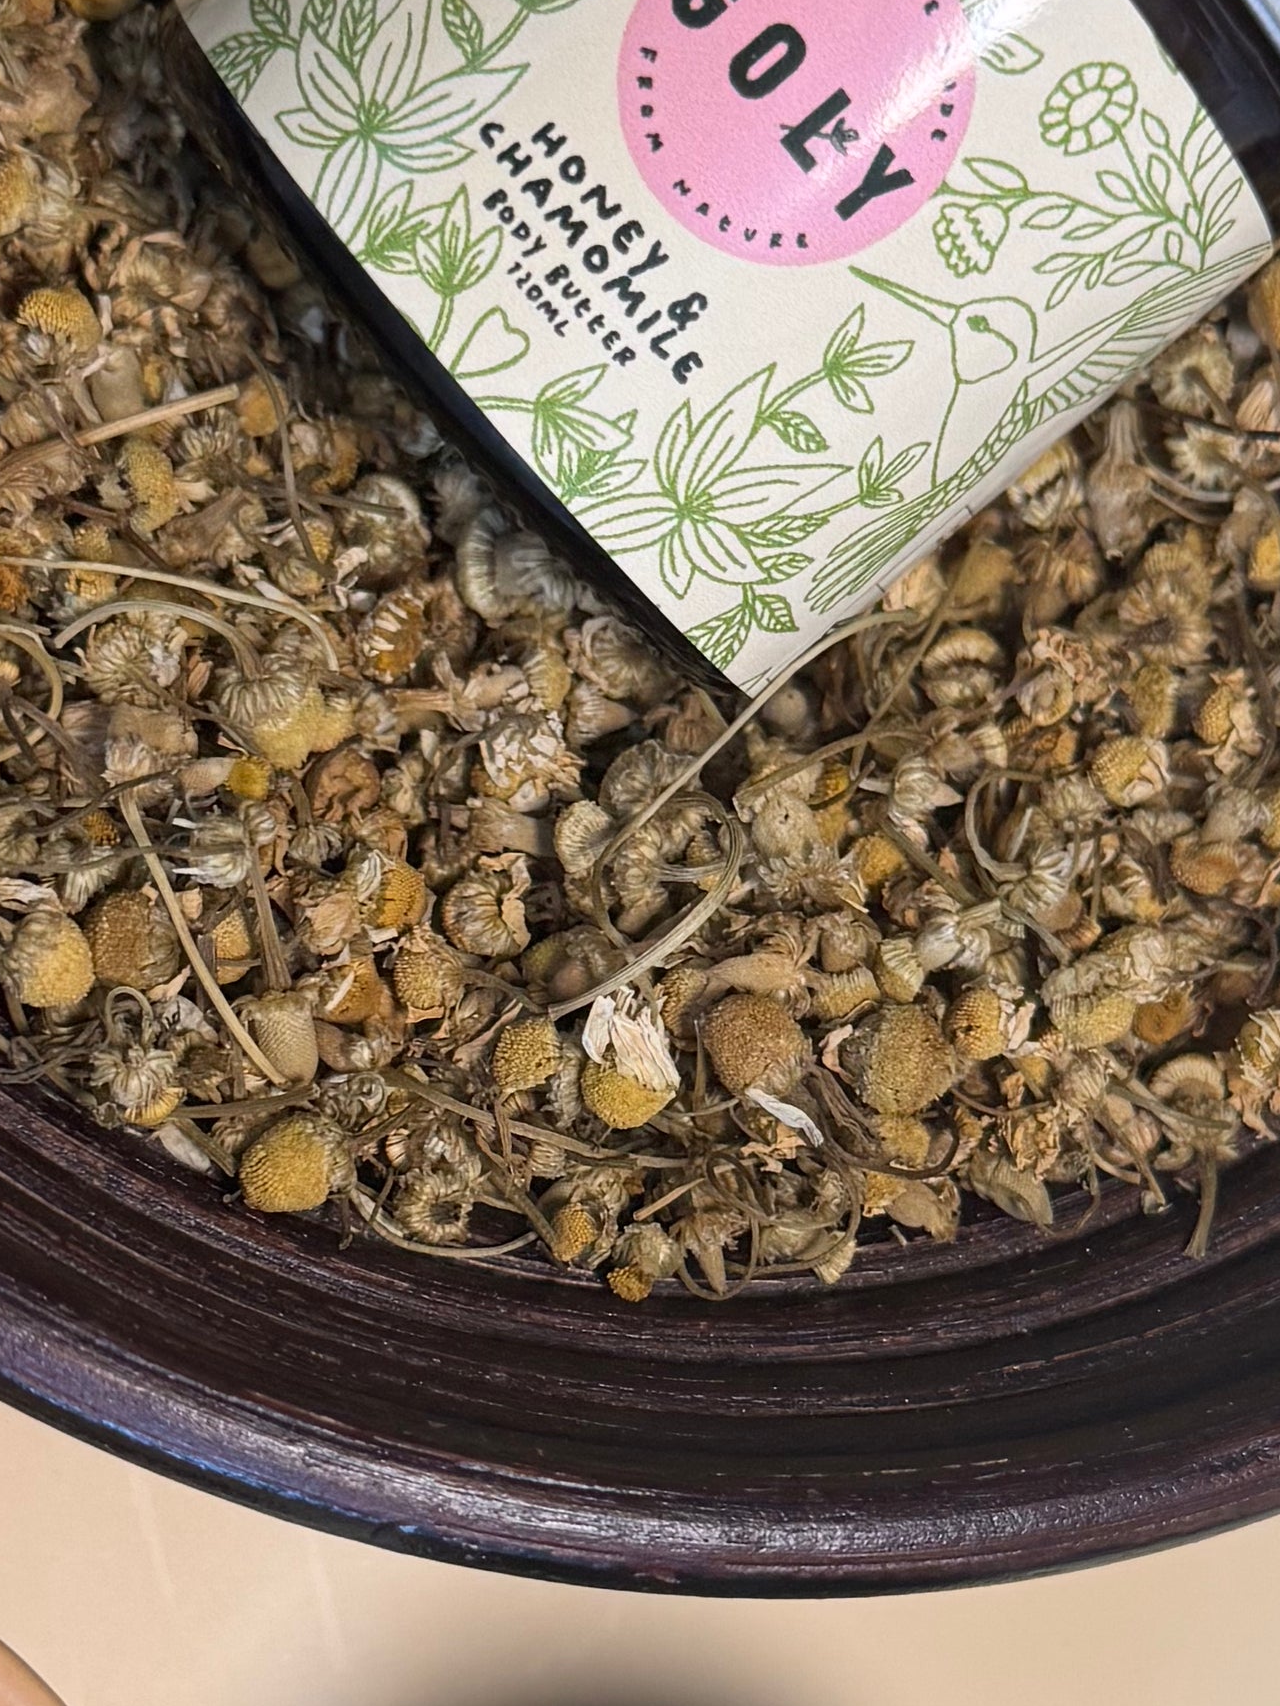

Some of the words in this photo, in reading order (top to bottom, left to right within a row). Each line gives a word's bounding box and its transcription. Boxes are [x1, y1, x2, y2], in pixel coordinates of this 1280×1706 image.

[636, 46, 664, 153] FROM
[479, 122, 704, 385] CHAMOMILE
[482, 188, 547, 258] BODY
[531, 122, 670, 277] HONEY
[667, 291, 708, 331] &
